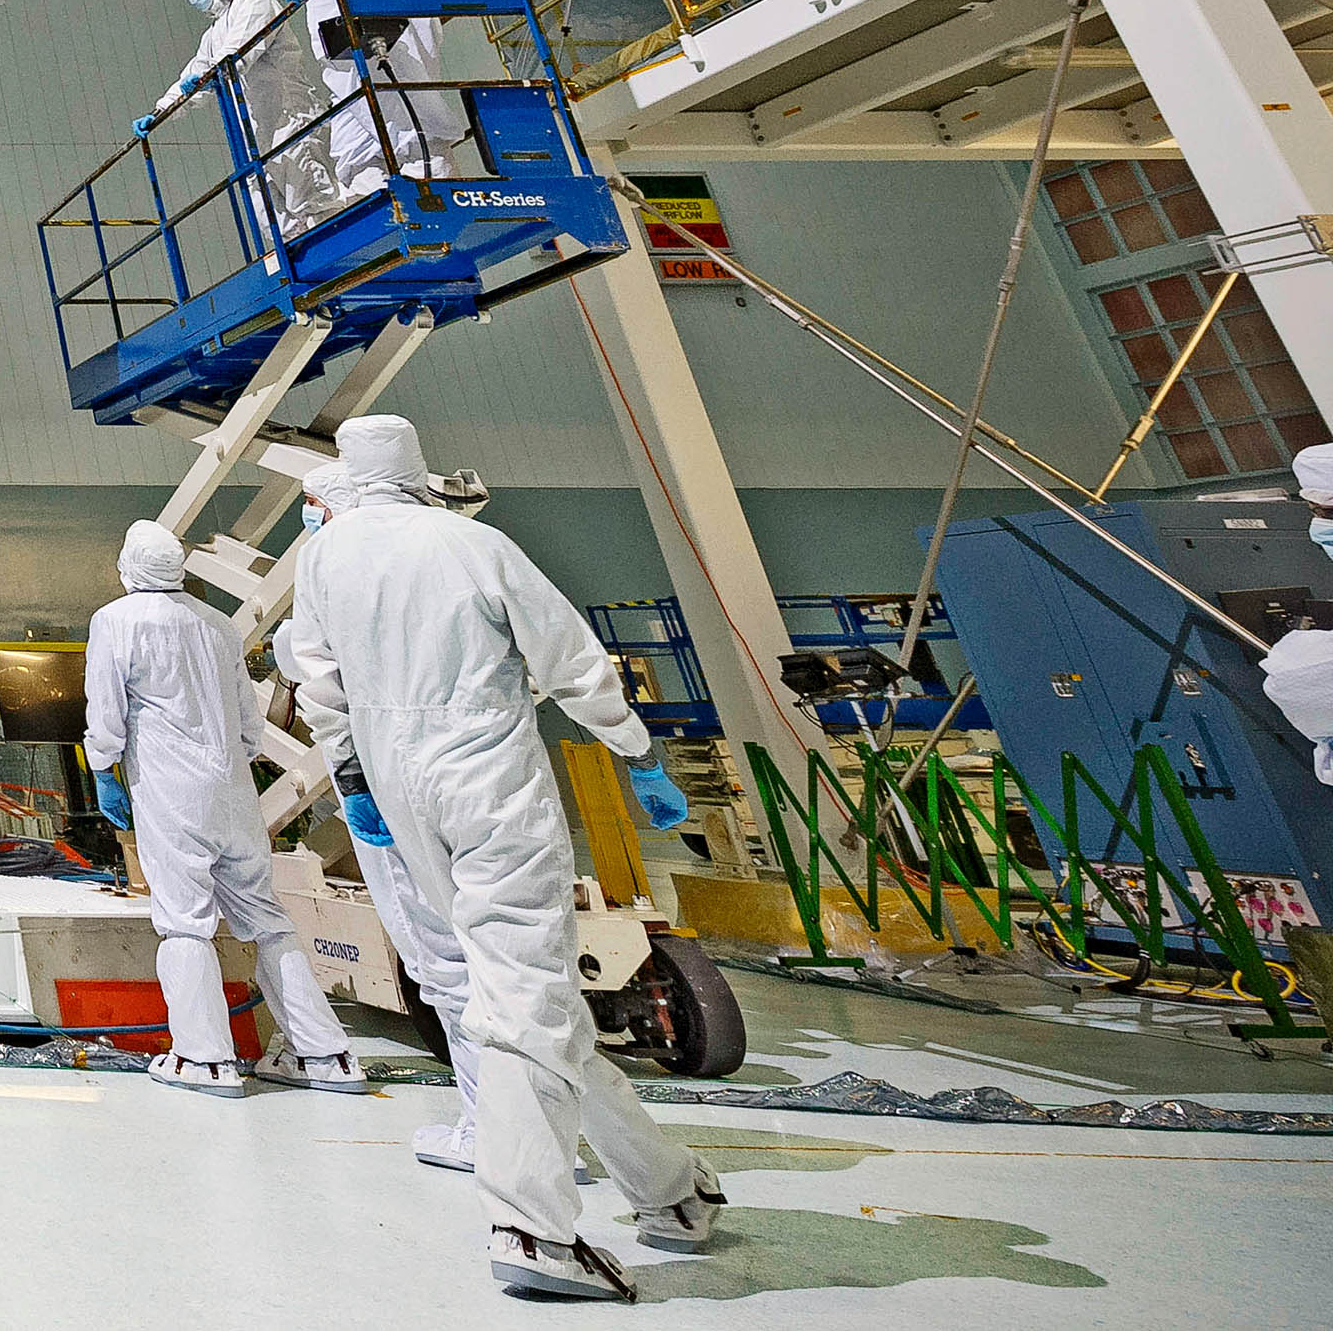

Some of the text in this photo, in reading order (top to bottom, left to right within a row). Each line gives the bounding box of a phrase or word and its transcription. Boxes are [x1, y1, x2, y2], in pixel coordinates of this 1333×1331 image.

[452, 190, 546, 207] CH-Series
[661, 261, 702, 278] LOW
[313, 937, 360, 963] CH20NEP
